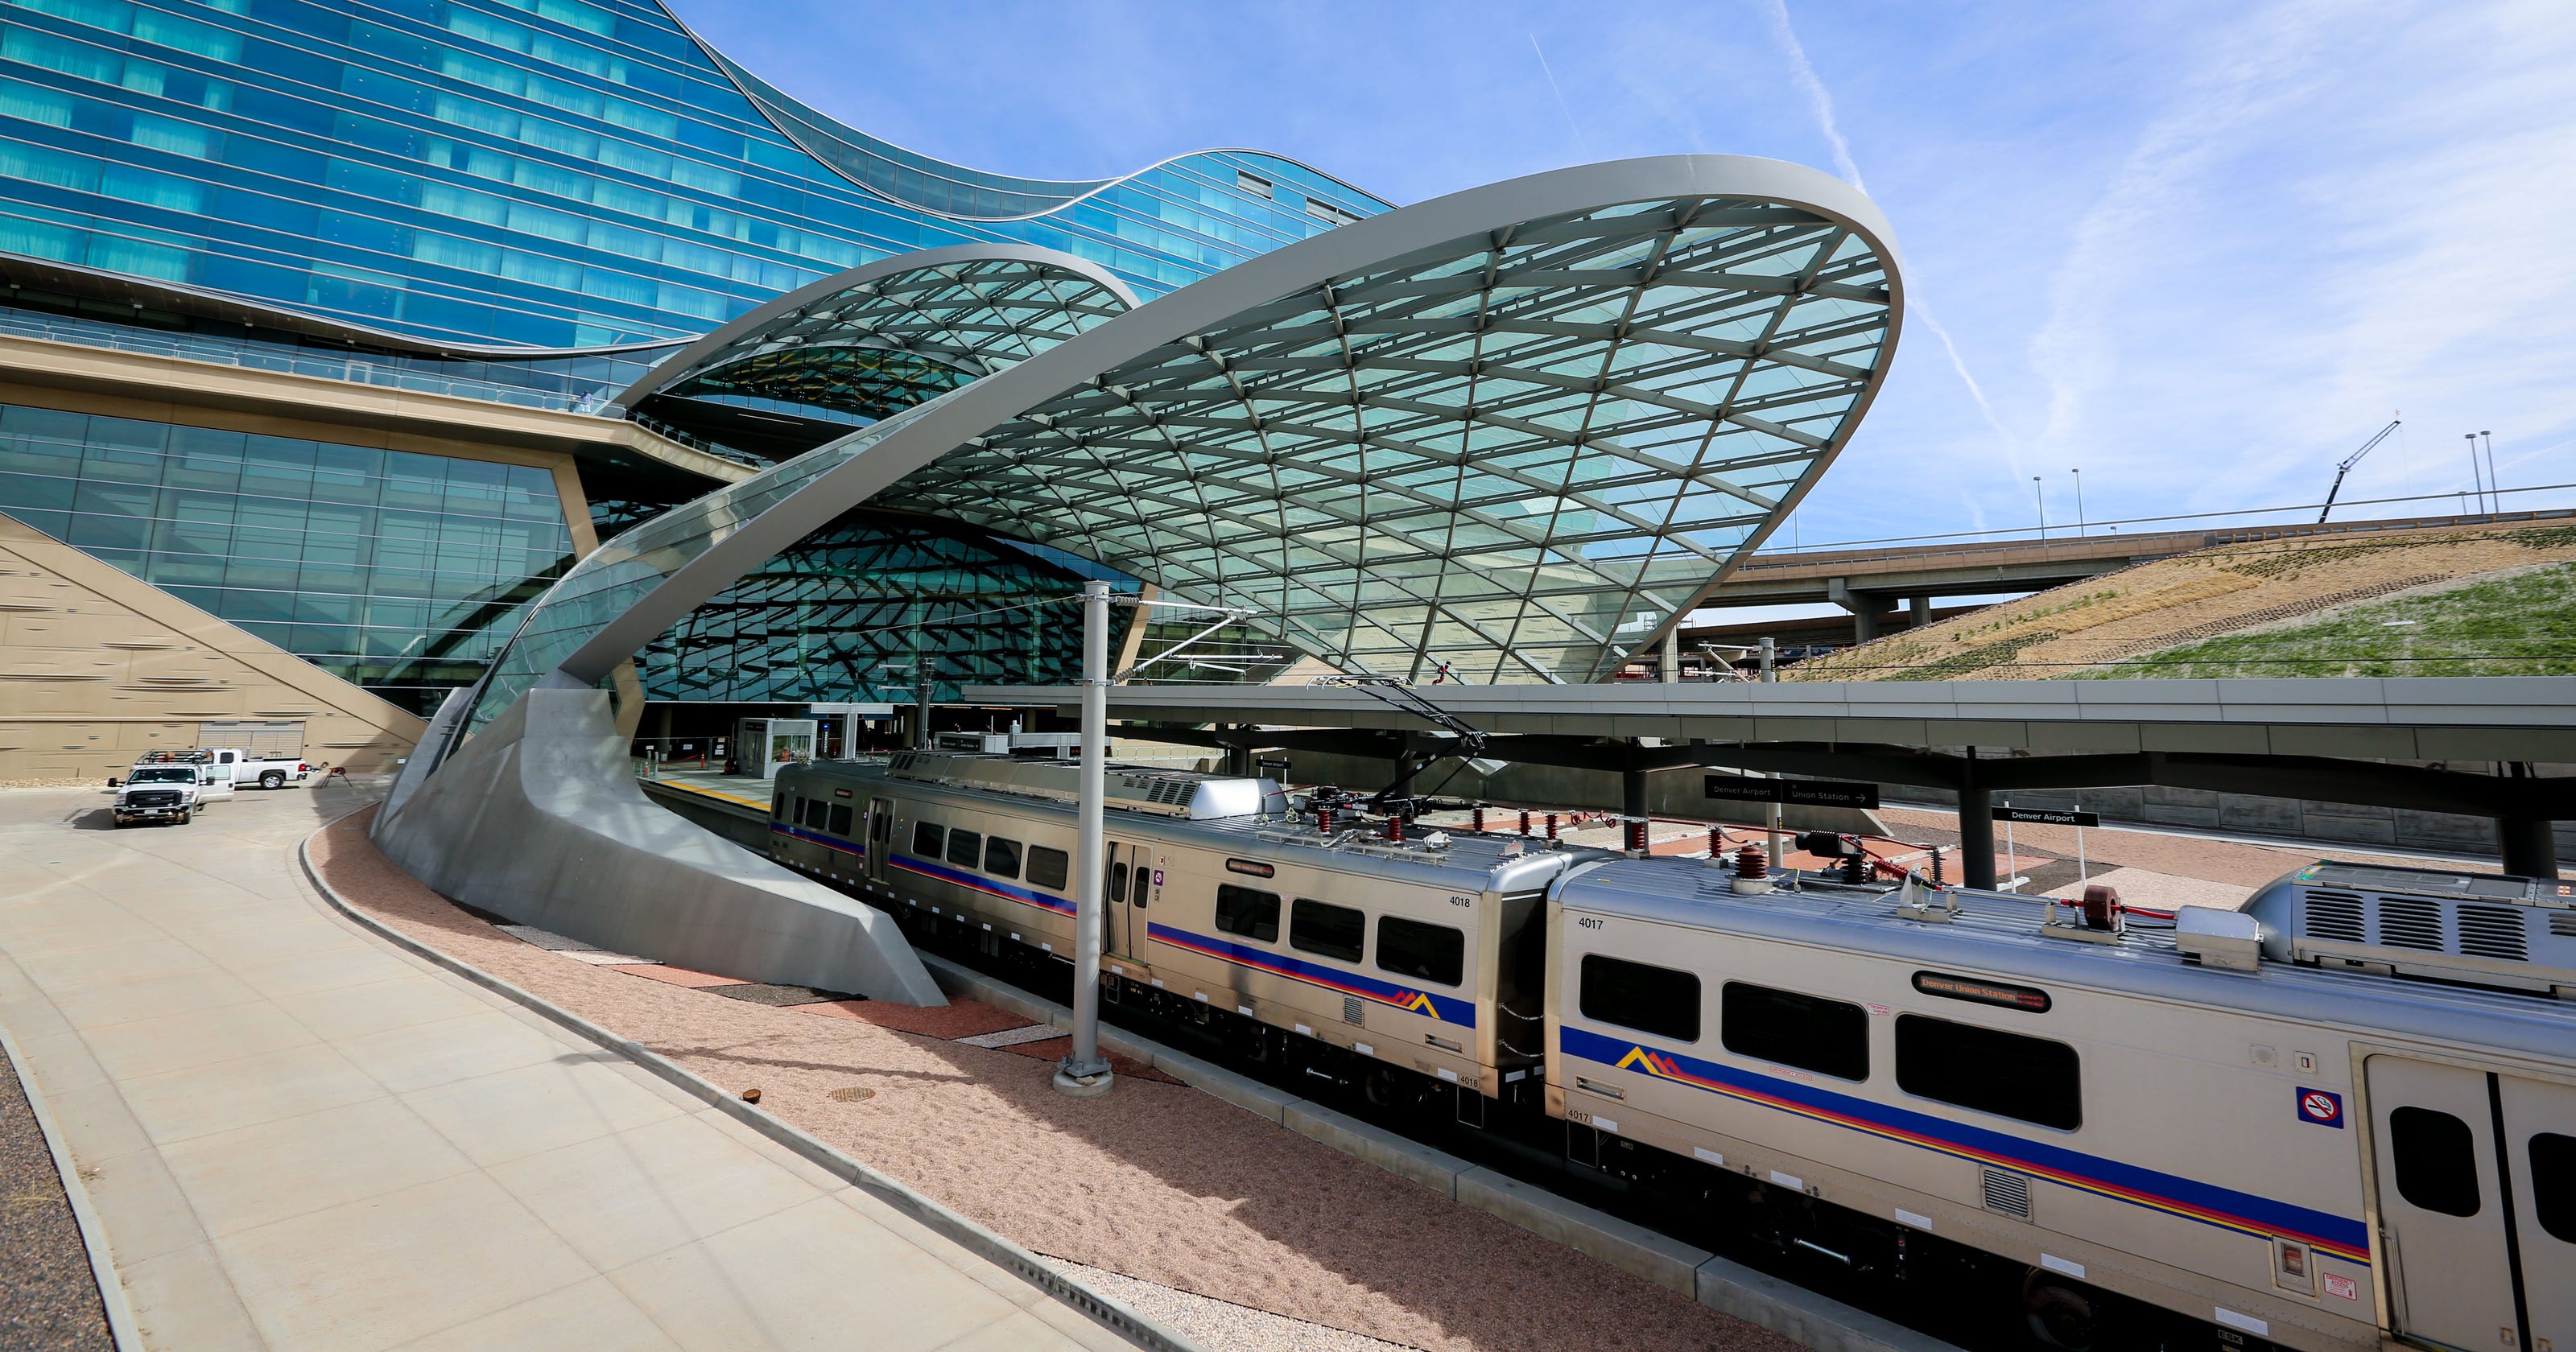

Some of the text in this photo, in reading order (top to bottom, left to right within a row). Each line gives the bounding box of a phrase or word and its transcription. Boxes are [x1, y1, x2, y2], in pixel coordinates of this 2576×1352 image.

[1714, 785, 1771, 796] Denver Airport
[1792, 790, 1850, 801] Union Station
[2012, 811, 2075, 822] Denver Airport
[1450, 896, 1470, 908] 4018
[1579, 917, 1604, 930] 4017
[1922, 978, 1953, 991] Denver
[1955, 984, 1980, 995] Union
[1982, 988, 2016, 1000] Station
[1460, 1075, 1478, 1087] 4018
[1568, 1109, 1589, 1123] 4017
[2220, 1331, 2241, 1342] ESK
